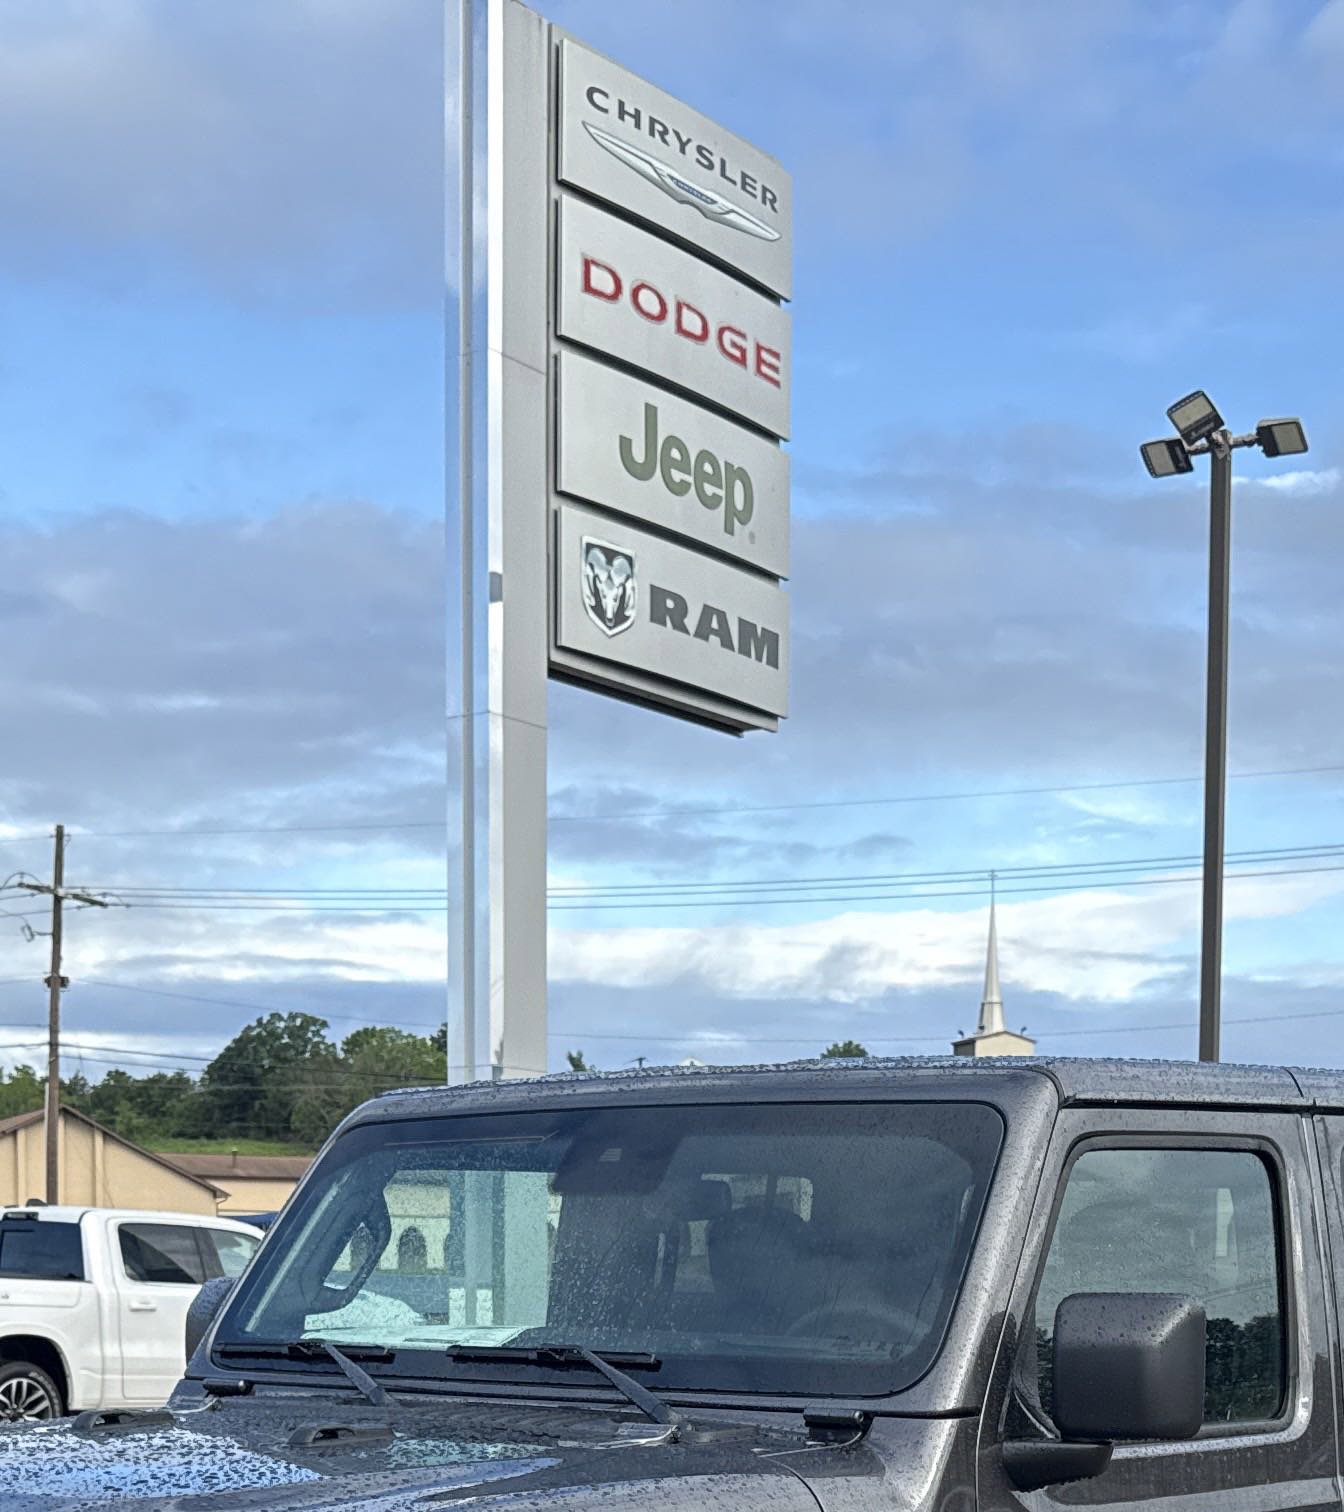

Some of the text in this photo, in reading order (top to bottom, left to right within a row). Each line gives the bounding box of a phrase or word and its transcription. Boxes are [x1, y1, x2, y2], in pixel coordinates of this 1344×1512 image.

[585, 85, 779, 214] CHRYSLER
[581, 255, 782, 389] DODGE
[618, 402, 754, 536] Jeep
[649, 583, 779, 670] RAM
